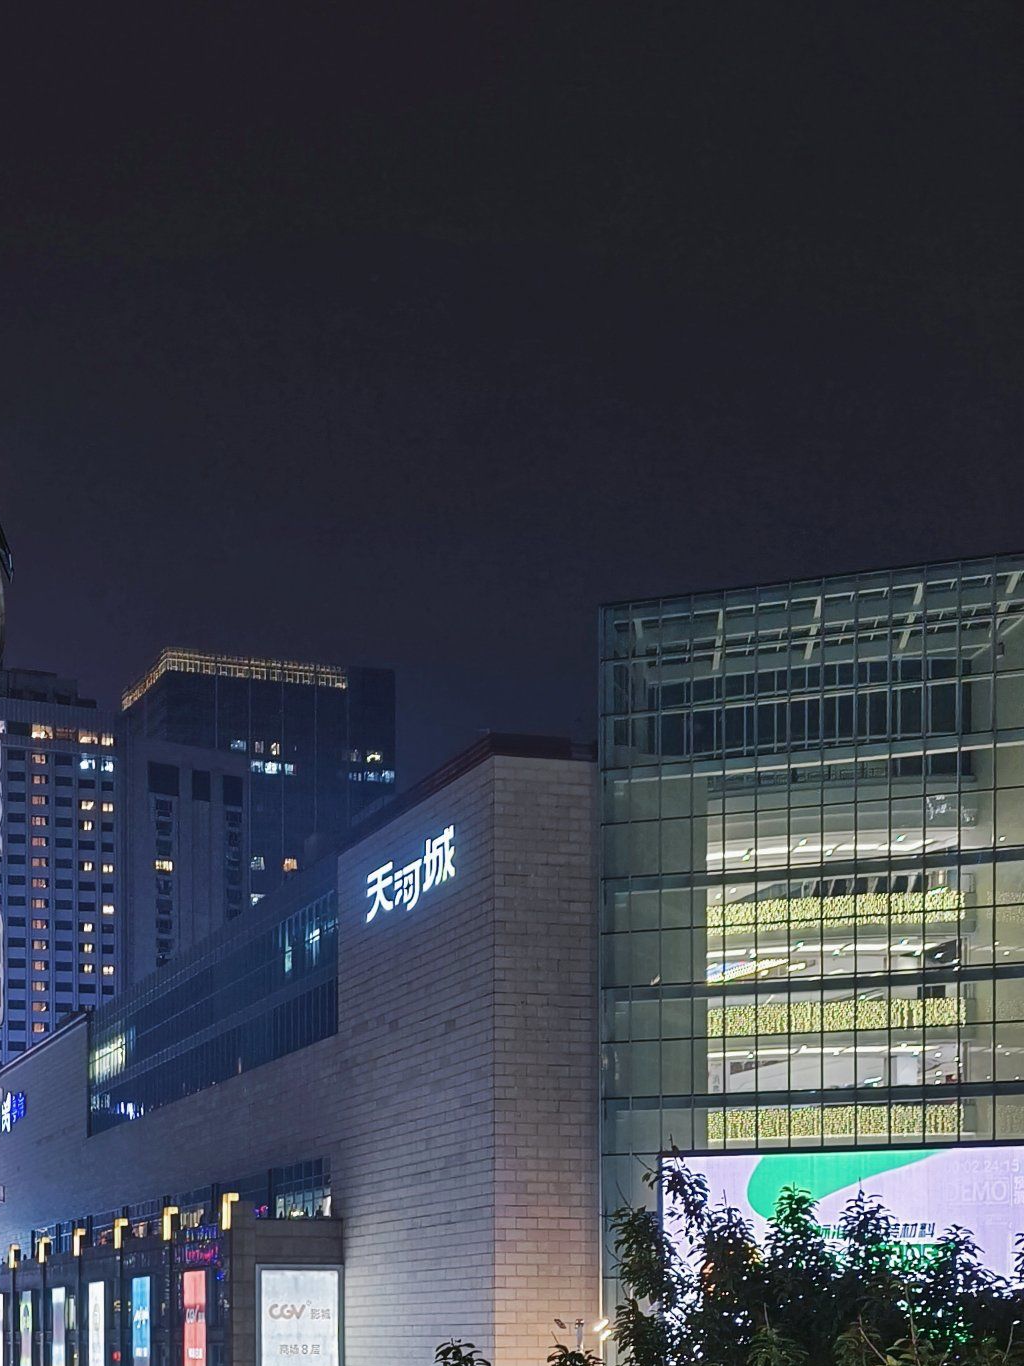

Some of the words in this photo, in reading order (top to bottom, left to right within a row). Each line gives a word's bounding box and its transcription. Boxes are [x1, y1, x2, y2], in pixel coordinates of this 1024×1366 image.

[365, 824, 456, 924] 天河城
[268, 1303, 307, 1320] CGV
